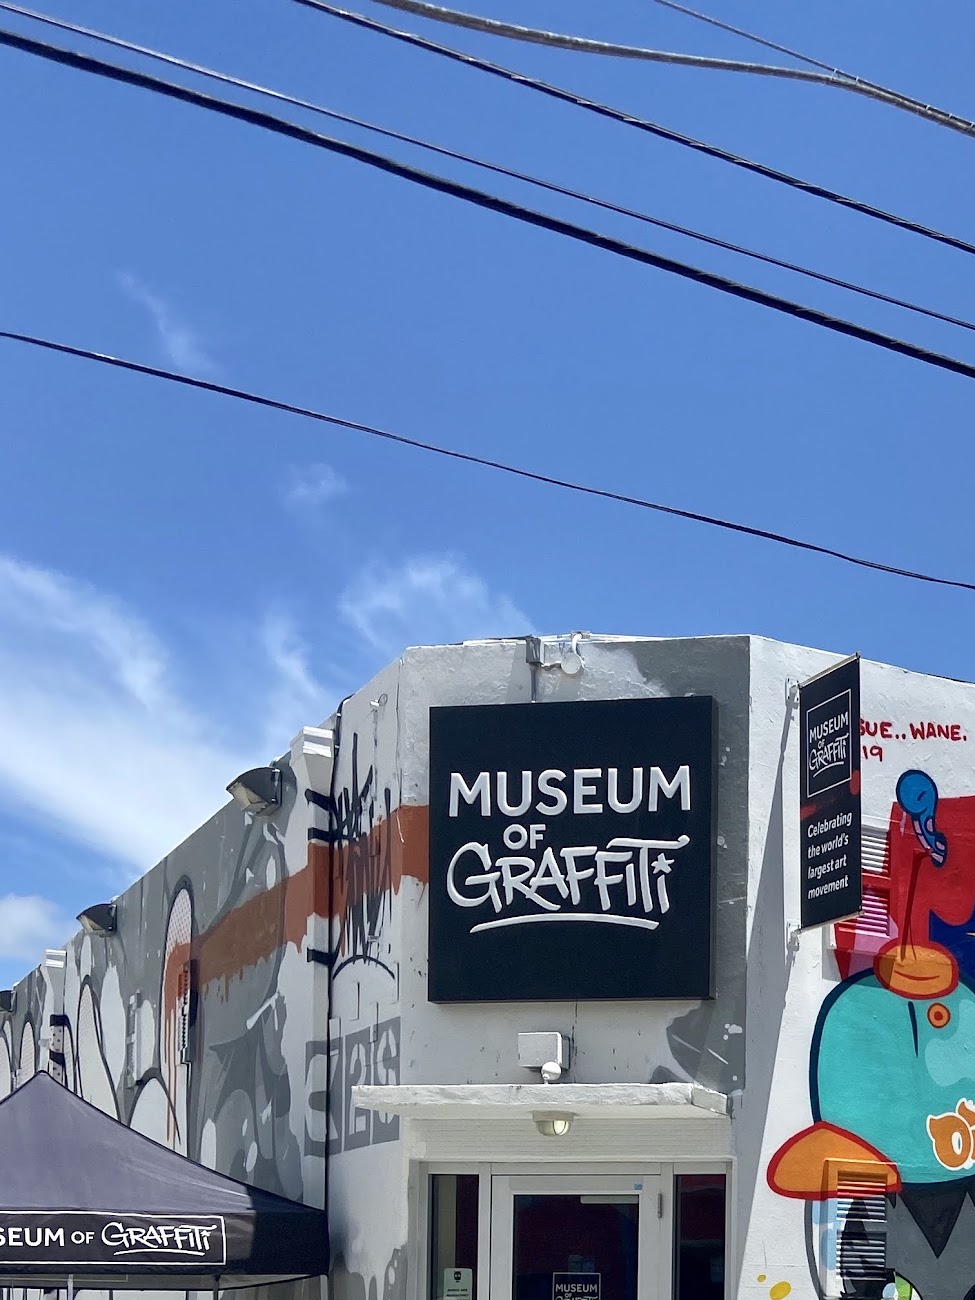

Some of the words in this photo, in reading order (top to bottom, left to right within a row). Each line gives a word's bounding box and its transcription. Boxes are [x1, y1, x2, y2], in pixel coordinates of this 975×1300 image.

[809, 711, 849, 743] MUSEUM
[818, 739, 825, 749] OF
[449, 765, 691, 817] MUSEUM
[503, 824, 546, 850] OF
[807, 812, 853, 838] Celebrating
[808, 845, 820, 859] the
[821, 833, 849, 854] world's
[808, 859, 834, 880] largest
[834, 854, 847, 869] art
[808, 875, 849, 900] movement
[71, 1231, 95, 1245] OF
[555, 1283, 598, 1293] MUSEUM
